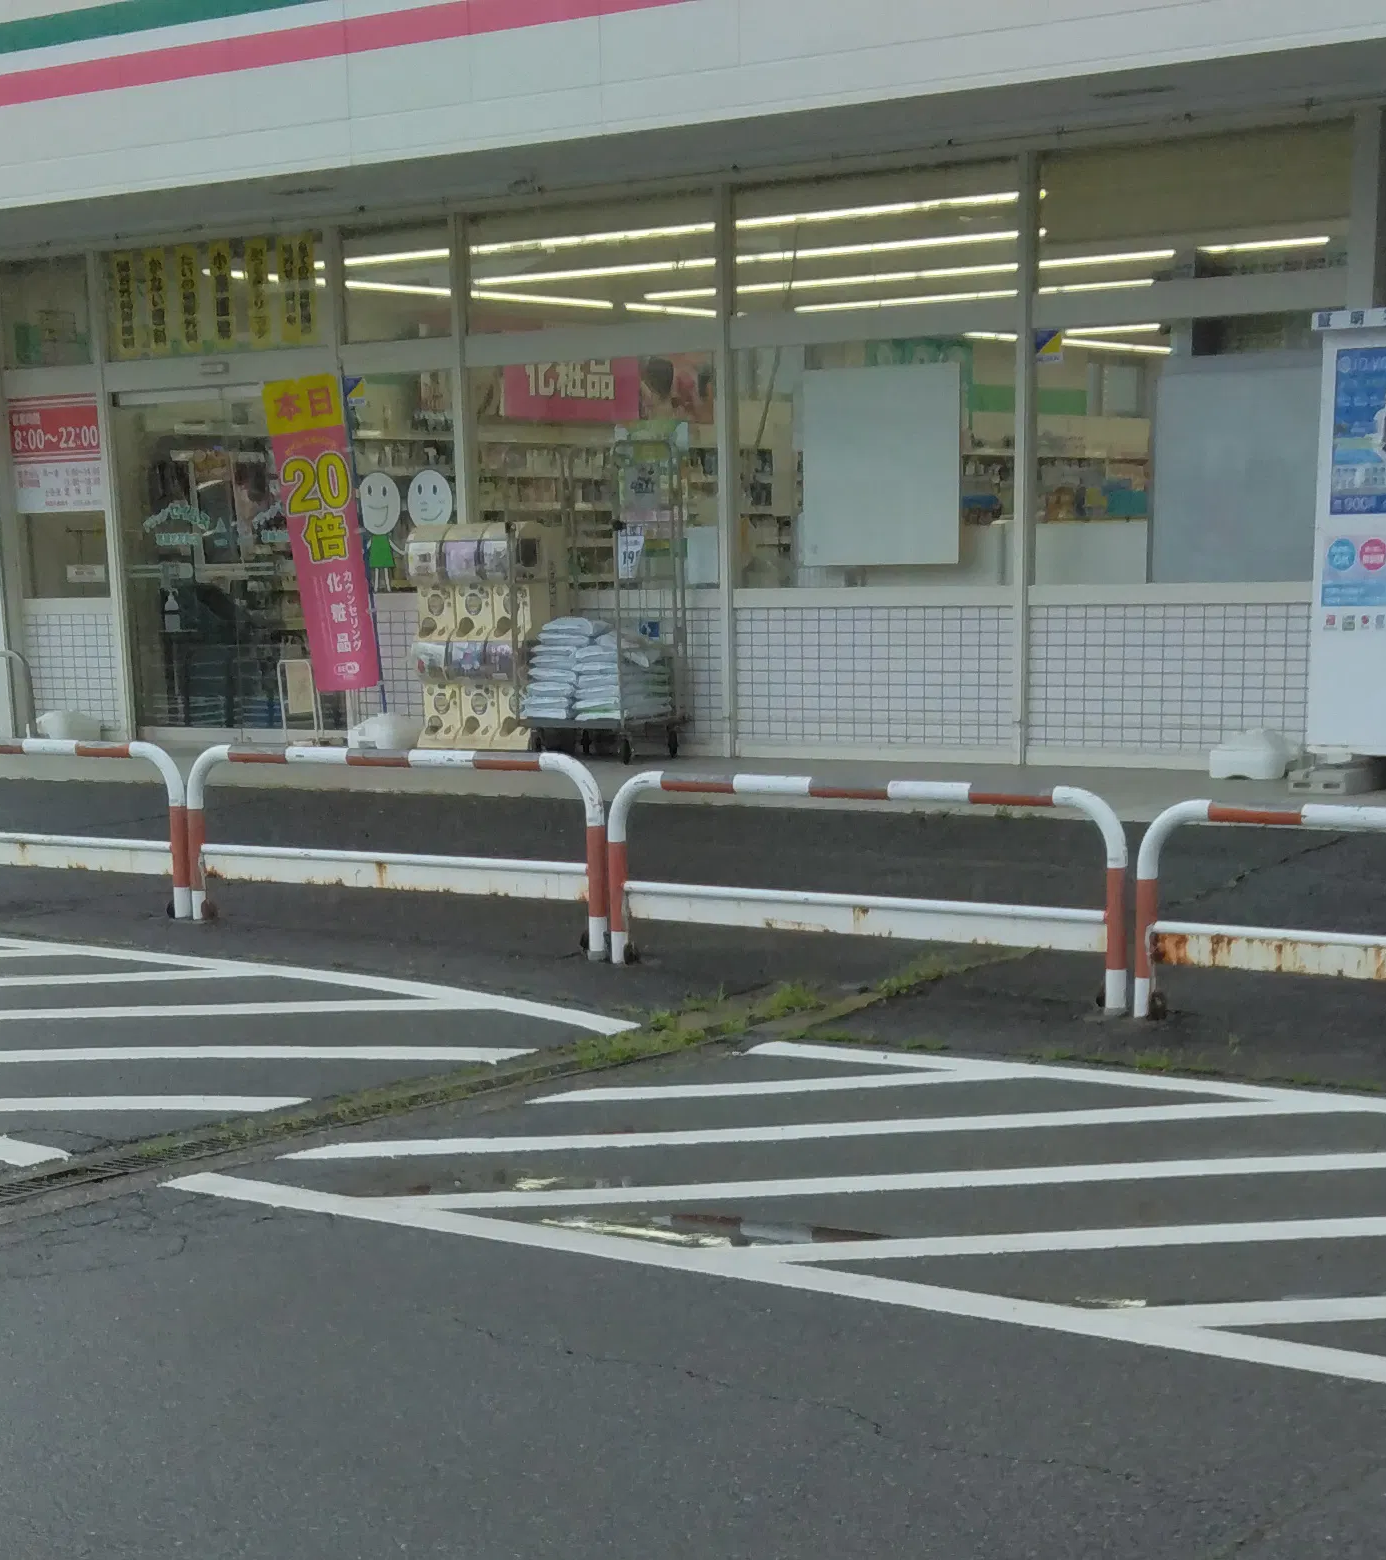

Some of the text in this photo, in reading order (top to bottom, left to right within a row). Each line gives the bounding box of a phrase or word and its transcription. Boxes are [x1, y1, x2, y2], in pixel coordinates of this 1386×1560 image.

[273, 386, 334, 421] 本日
[326, 572, 352, 653] 化粧品
[343, 570, 363, 652] カウンセリング
